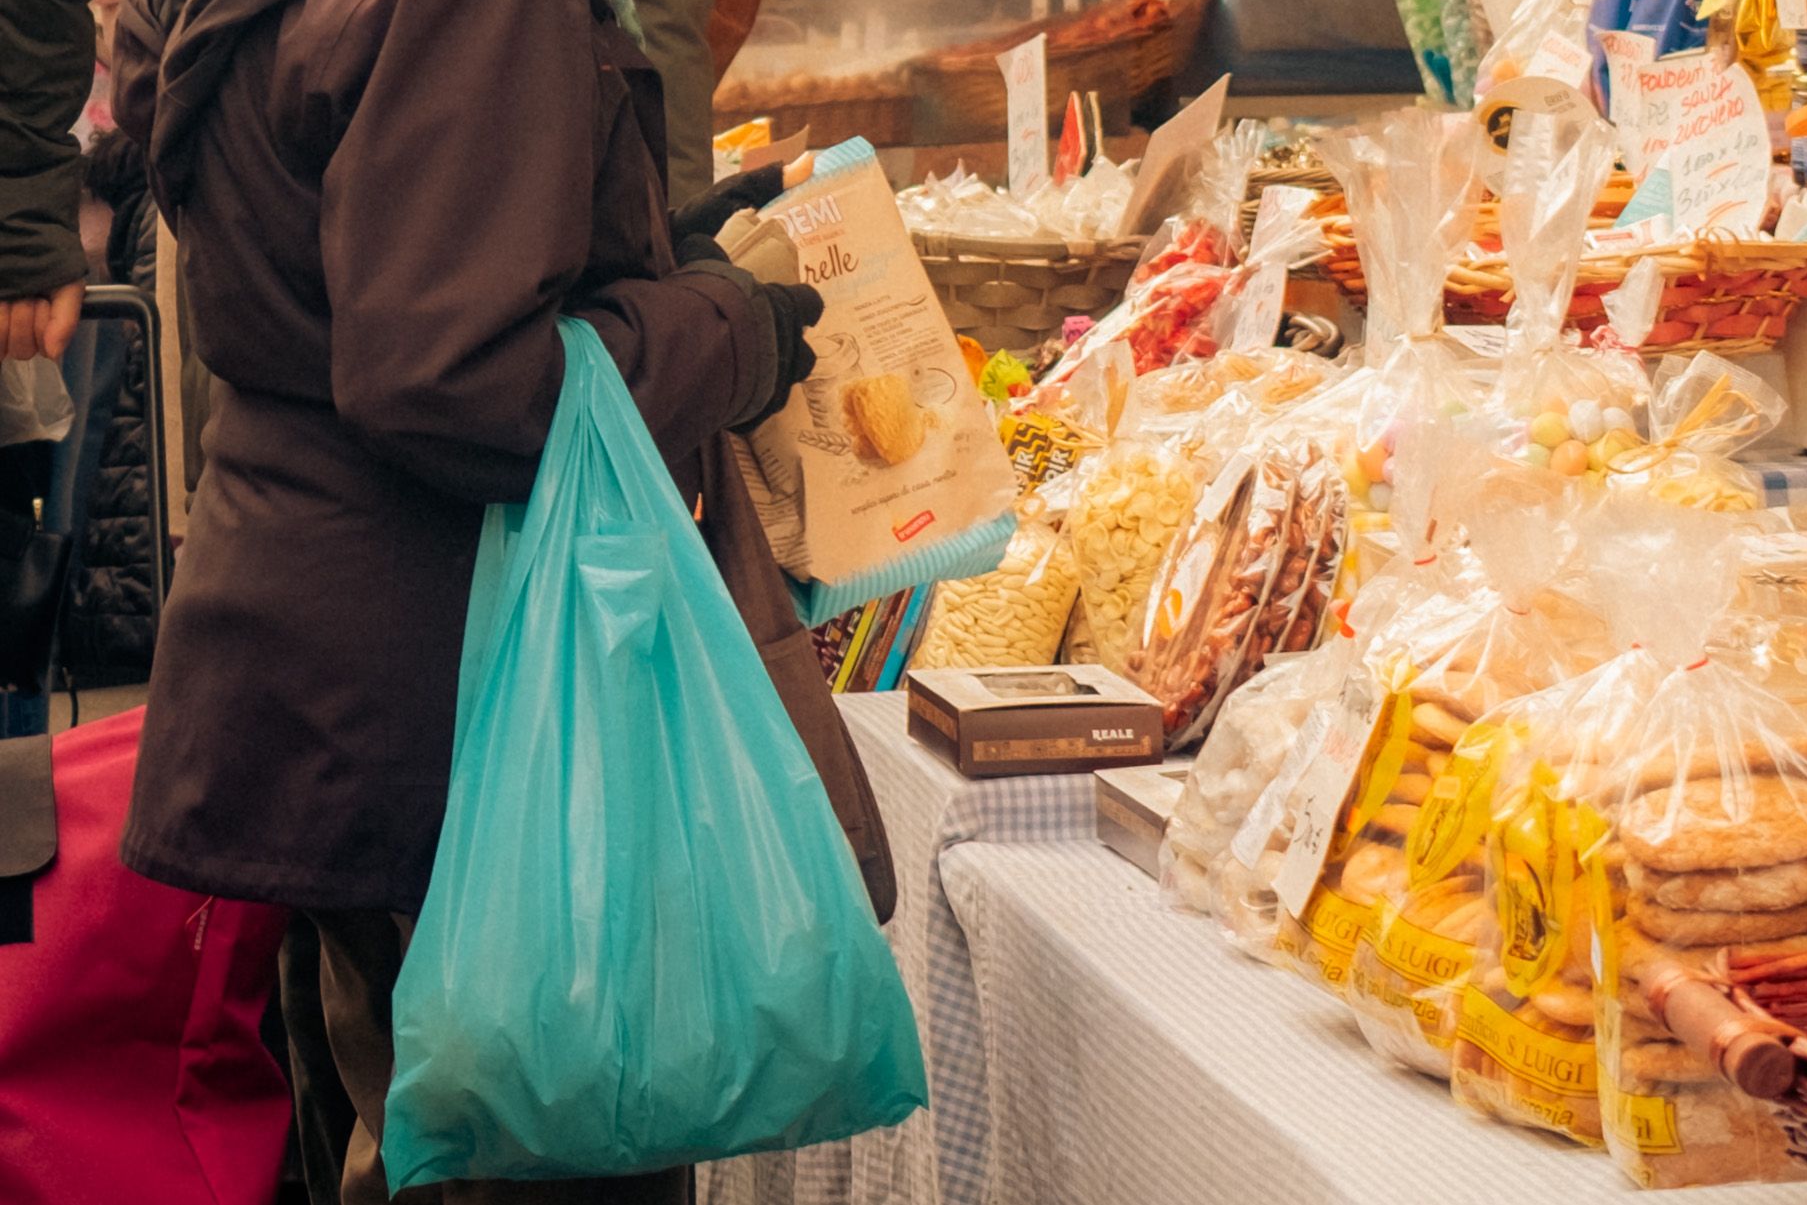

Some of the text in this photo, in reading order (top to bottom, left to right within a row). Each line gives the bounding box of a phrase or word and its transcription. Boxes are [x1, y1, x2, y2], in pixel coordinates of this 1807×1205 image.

[1091, 728, 1134, 741] REALE
[1398, 941, 1461, 980] LUIGI
[1522, 1046, 1586, 1084] LUIGI
